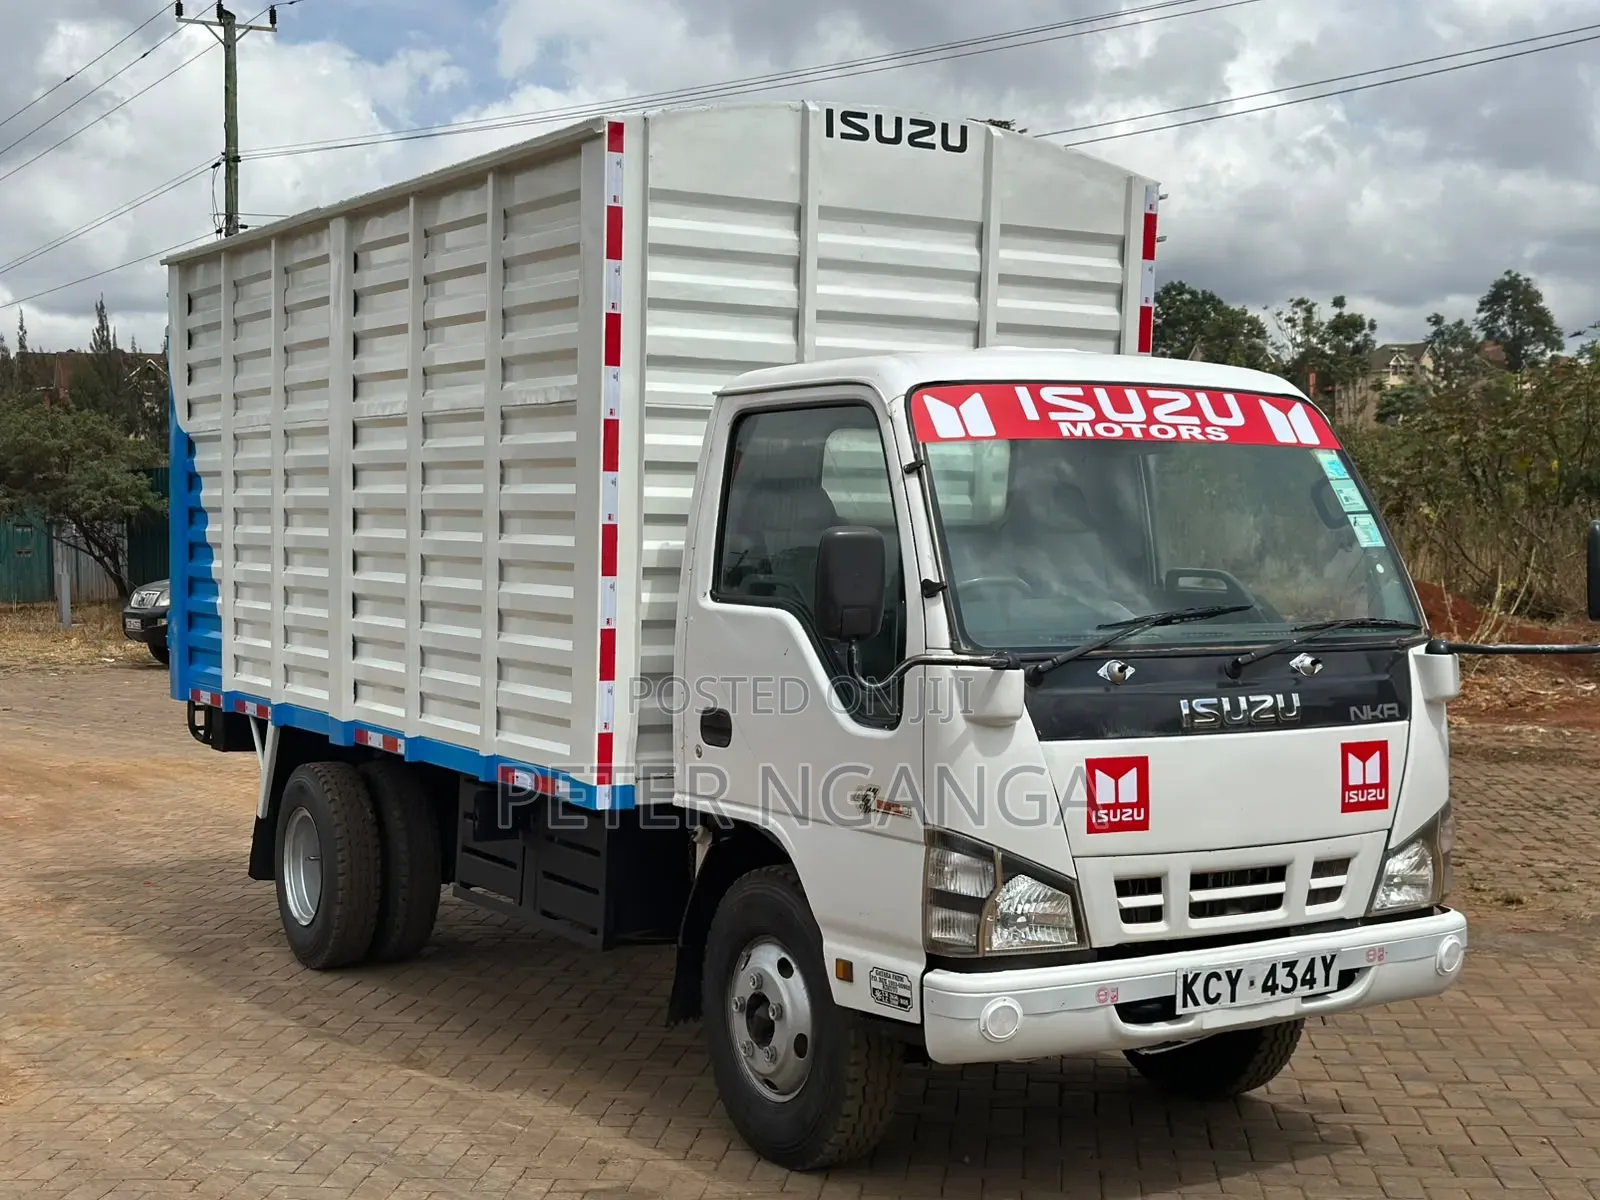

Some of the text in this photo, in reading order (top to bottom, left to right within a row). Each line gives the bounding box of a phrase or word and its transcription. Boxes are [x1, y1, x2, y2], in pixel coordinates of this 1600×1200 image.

[825, 108, 968, 154] ISUZU
[1014, 386, 1246, 427] ISUZU
[1057, 421, 1230, 442] MOTORS
[1179, 692, 1301, 729] ISUZU
[1349, 703, 1400, 721] NKR
[1345, 788, 1385, 803] ISUZU
[1092, 807, 1145, 823] ISUZU
[1182, 953, 1337, 1009] KCY 434Y
